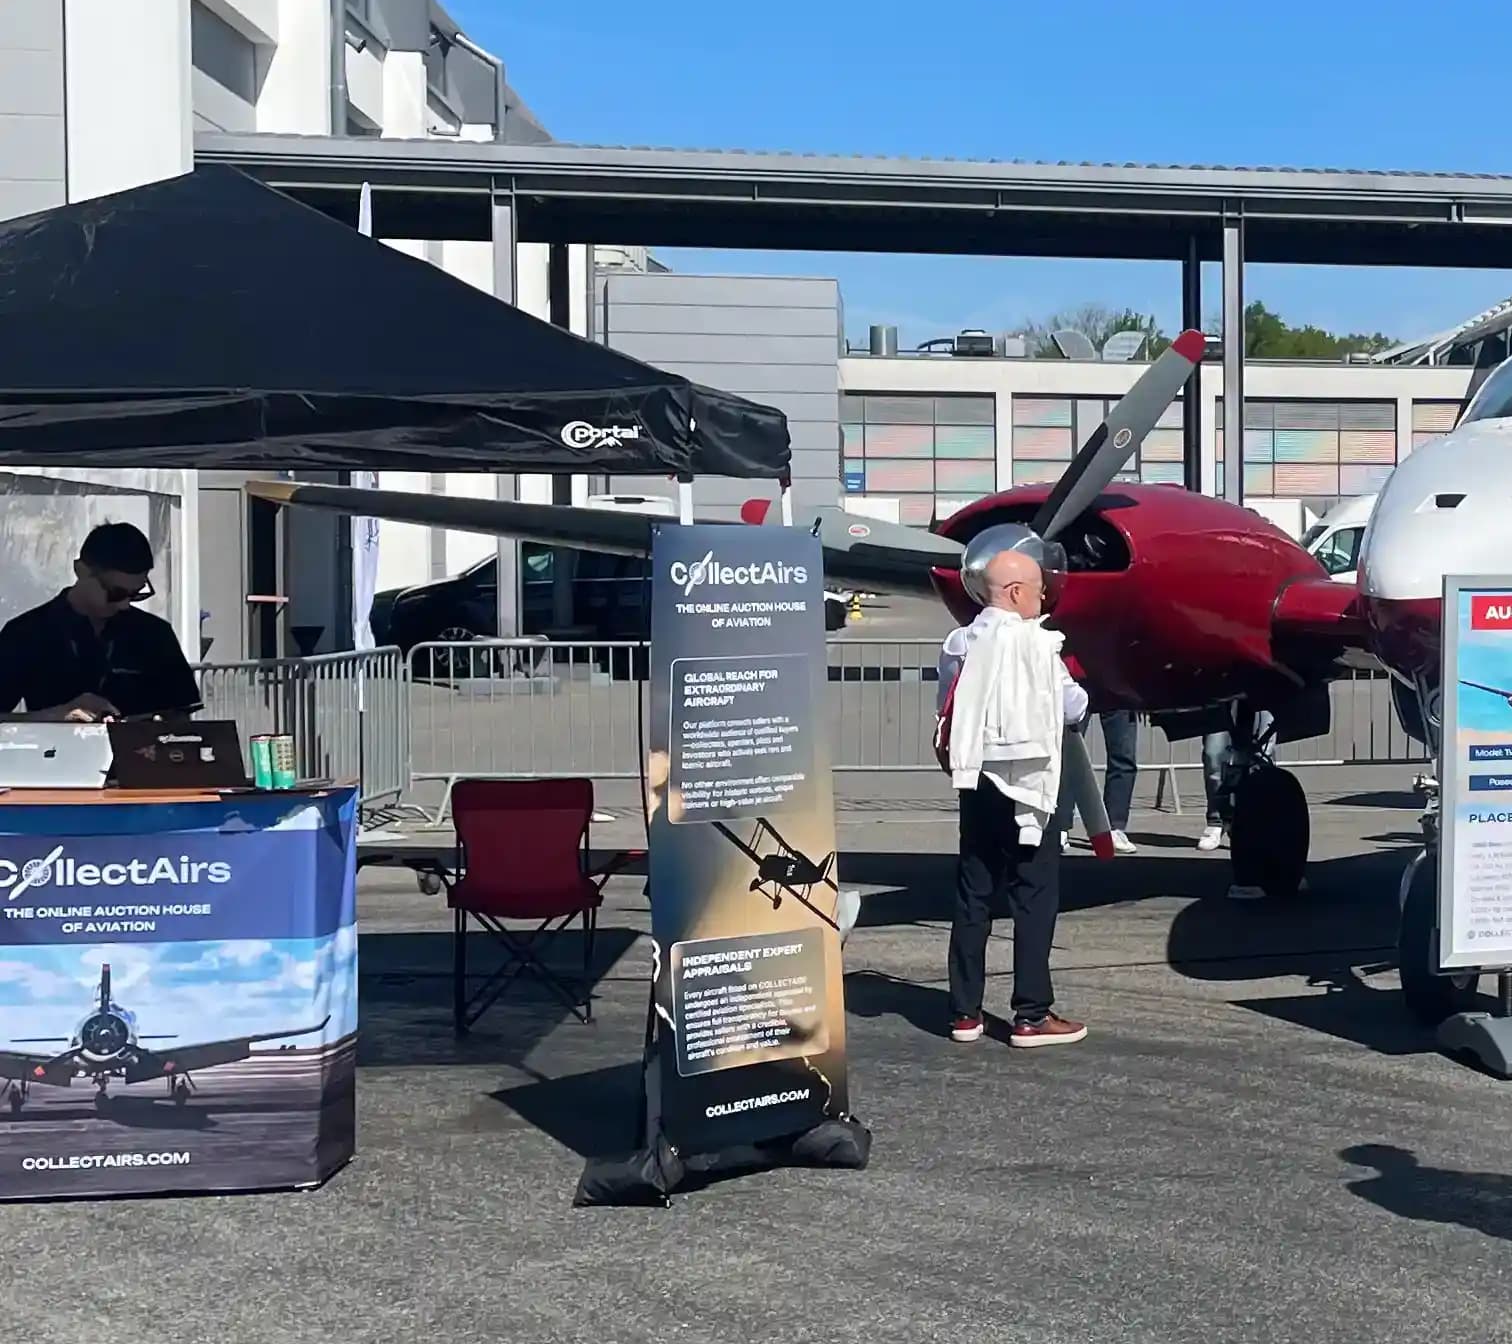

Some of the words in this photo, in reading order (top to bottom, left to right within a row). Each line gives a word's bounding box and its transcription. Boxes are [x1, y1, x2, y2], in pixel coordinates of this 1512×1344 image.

[670, 551, 808, 595] CollectAirs
[676, 603, 695, 614] THE
[696, 603, 730, 613] ONLINE
[732, 602, 774, 613] AUCTION
[775, 601, 807, 612] HOUSE
[712, 618, 724, 628] OF
[726, 616, 771, 627] AVIATION
[684, 672, 725, 683] GLOBAL
[726, 670, 758, 682] REACH
[759, 669, 778, 680] FOR
[684, 682, 766, 696] EXTRAORDINARY
[684, 695, 735, 707] AIRCRAFT
[3, 906, 33, 919] THE
[36, 906, 92, 919] ONLINE
[95, 904, 161, 917] AUCTION
[163, 903, 212, 916] HOUSE
[62, 921, 84, 934] OF
[85, 920, 156, 933] AVIATION
[683, 949, 762, 967] INDEPENDENT
[763, 943, 803, 957] EXPERT
[683, 961, 752, 979] APPRAISALS
[706, 1089, 810, 1118] COLLECTAIRS.COM
[22, 1152, 190, 1170] COLLECTAIRS.COM
